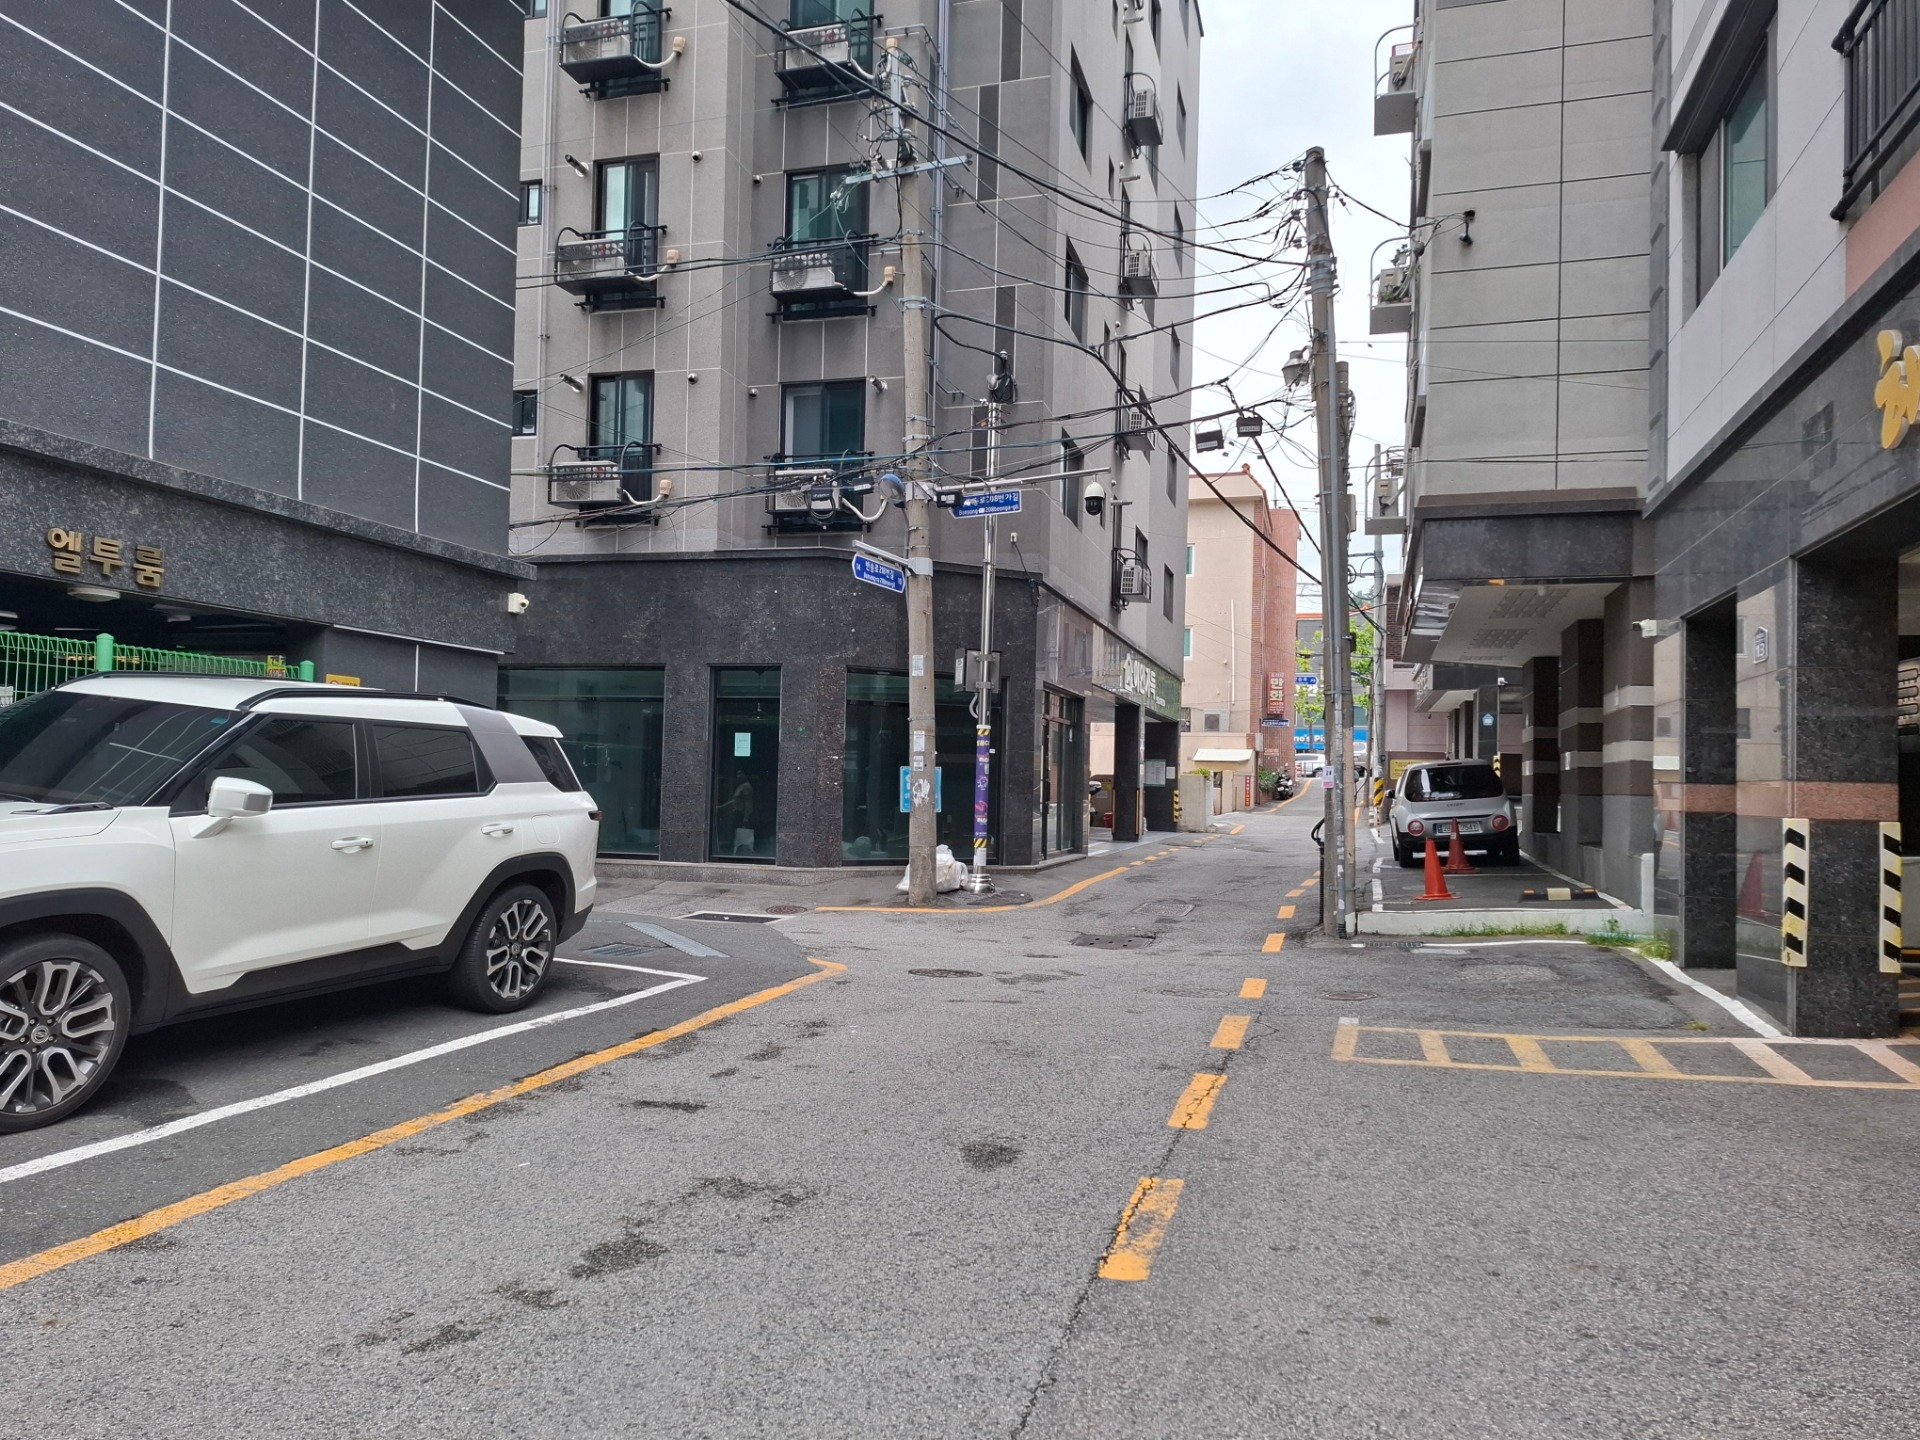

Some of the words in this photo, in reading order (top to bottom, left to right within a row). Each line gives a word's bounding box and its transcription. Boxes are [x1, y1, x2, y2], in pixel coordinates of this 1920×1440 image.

[47, 528, 165, 587] 엘투룸
[1755, 642, 1765, 657] 13
[1270, 677, 1284, 702] 만화
